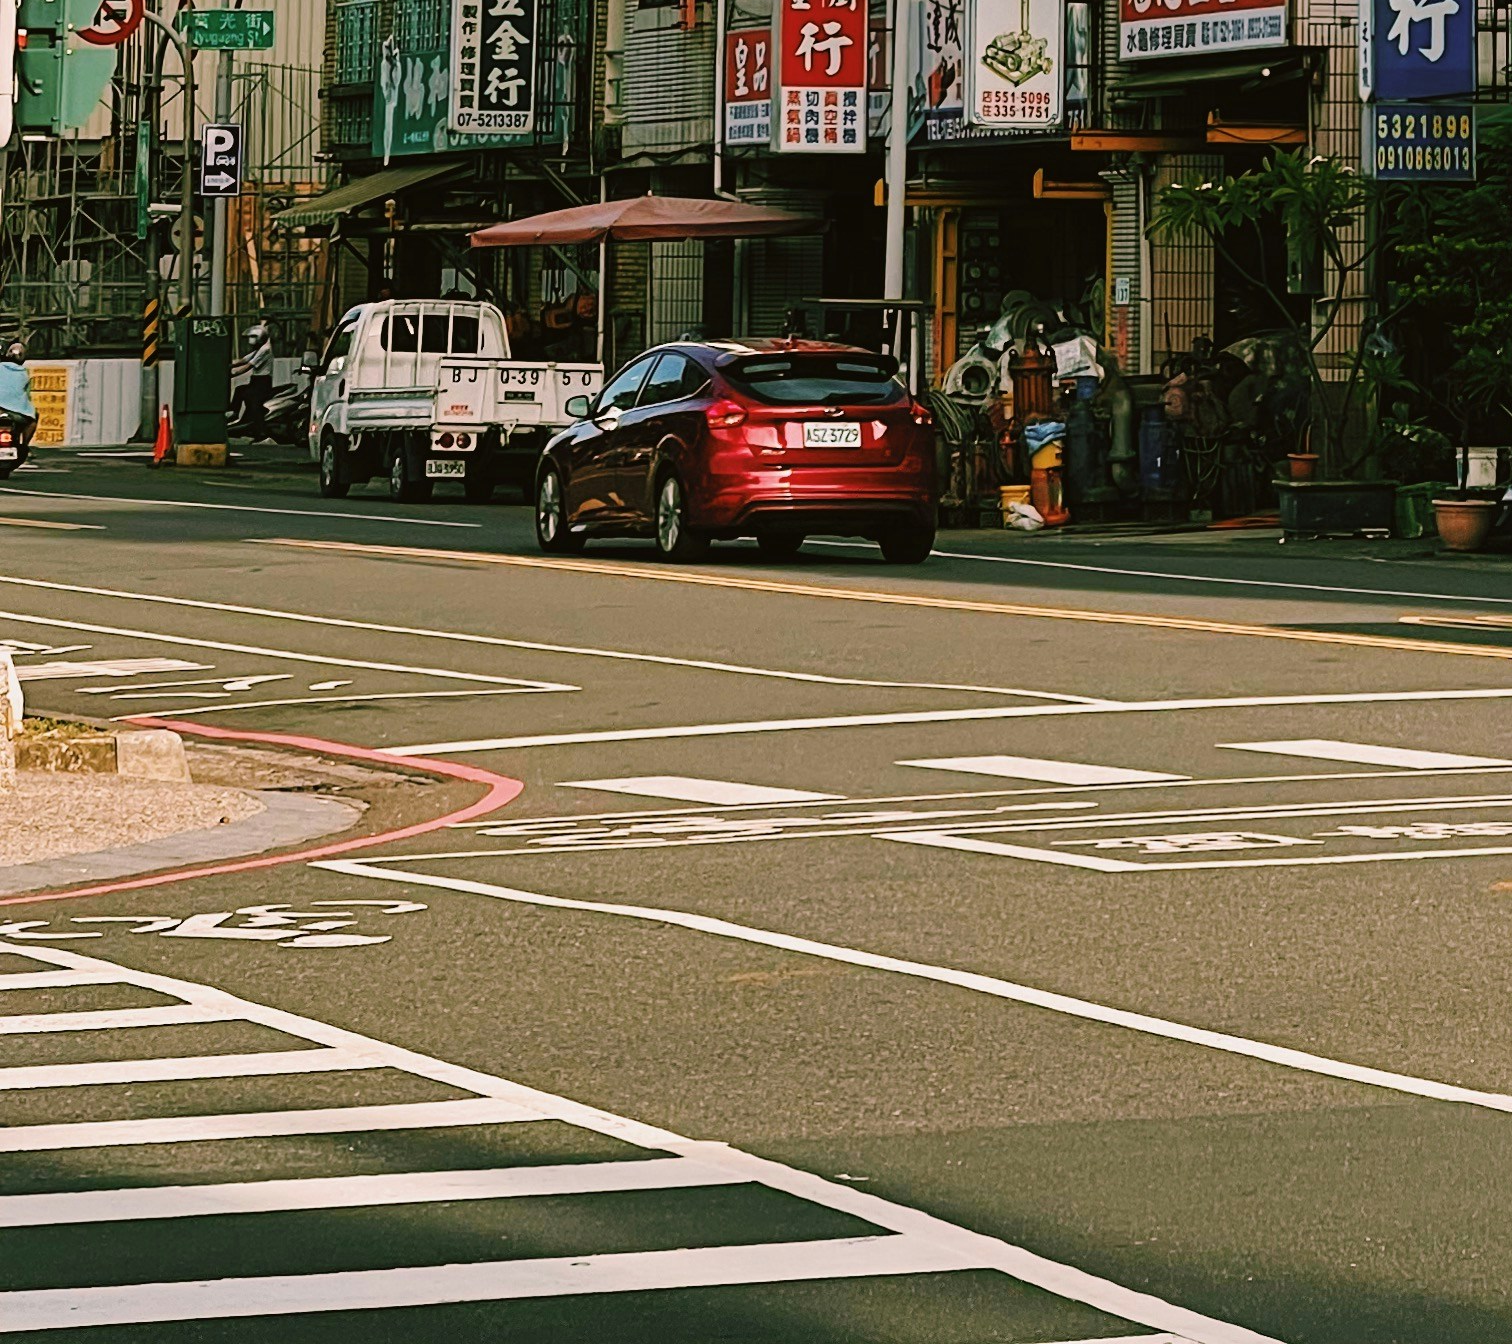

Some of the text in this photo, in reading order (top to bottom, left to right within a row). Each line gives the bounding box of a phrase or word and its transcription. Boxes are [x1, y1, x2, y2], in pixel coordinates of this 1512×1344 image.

[794, 20, 854, 77] 行
[457, 112, 529, 128] 07-5213387
[1378, 114, 1470, 140] 5321898
[1377, 145, 1470, 171] 0910863013
